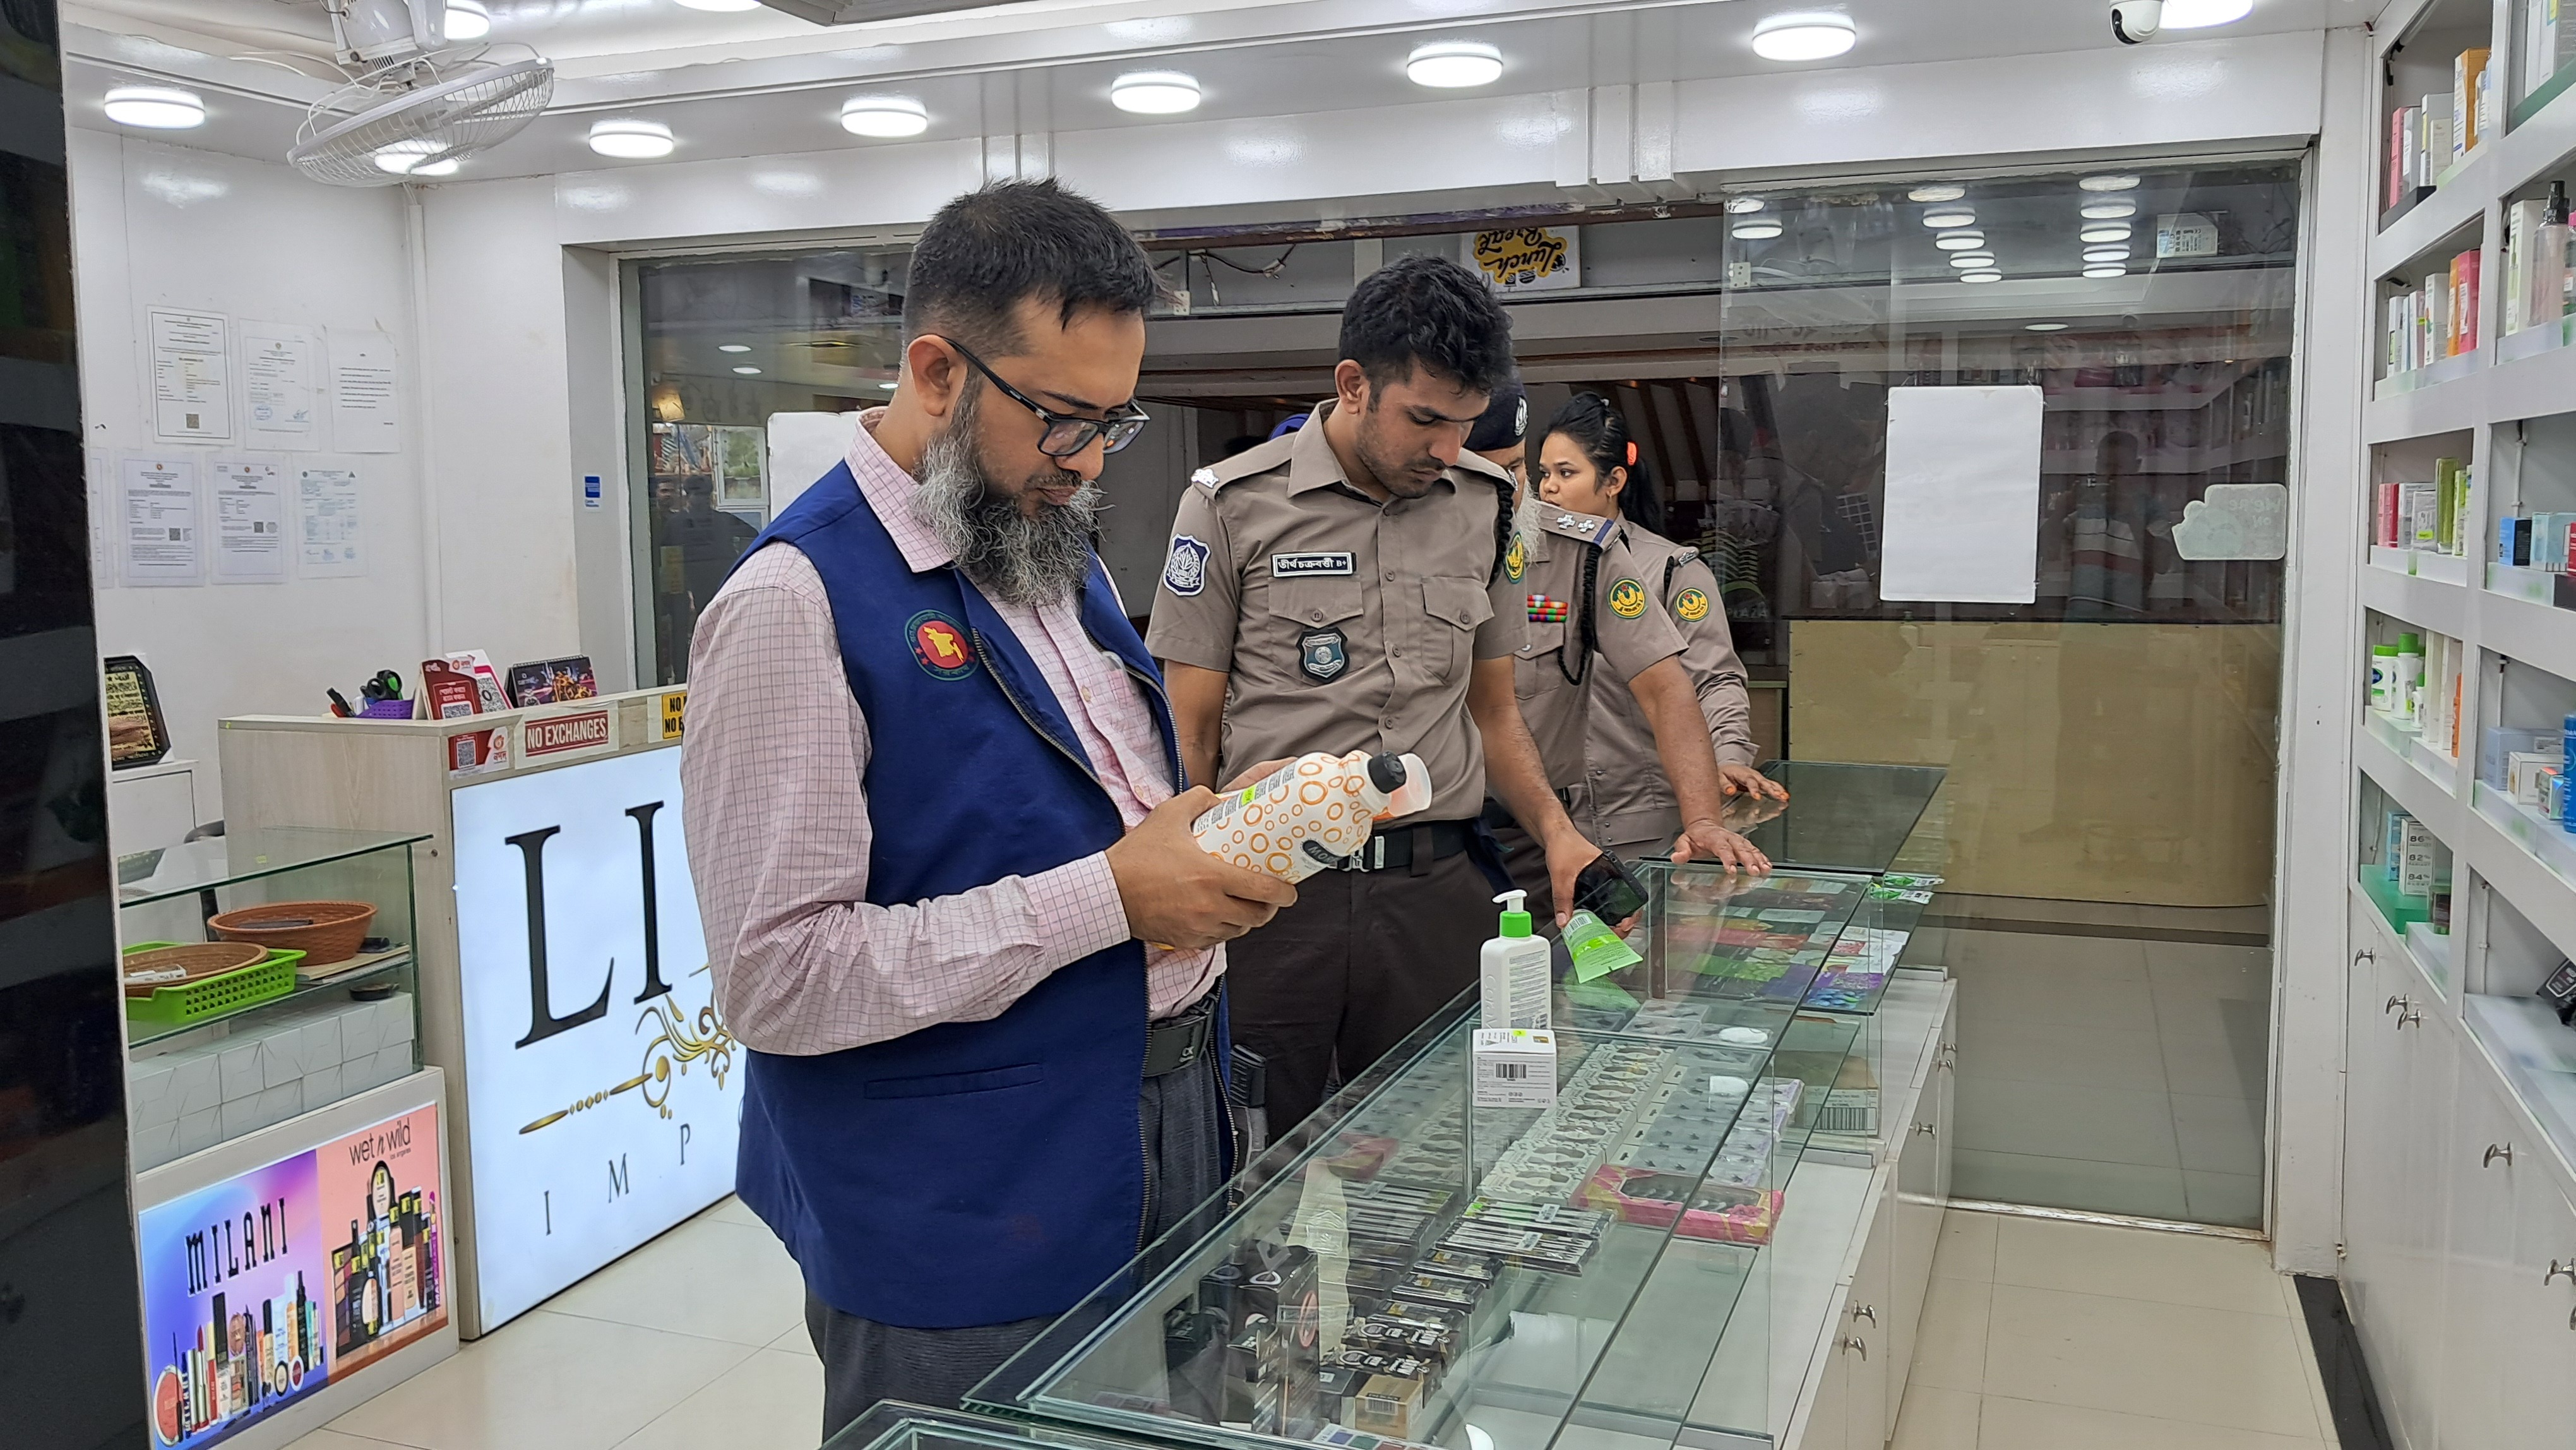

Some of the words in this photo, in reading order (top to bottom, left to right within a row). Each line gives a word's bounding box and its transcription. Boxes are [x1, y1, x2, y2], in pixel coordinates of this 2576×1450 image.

[1484, 241, 1562, 278] Lunch
[669, 697, 681, 712] NO
[527, 727, 542, 749] NO
[545, 718, 607, 746] EXCHANGES
[665, 717, 677, 733] NO
[349, 1132, 375, 1166] wet
[377, 1134, 385, 1156] n
[386, 1117, 411, 1151] wild
[185, 1197, 288, 1295] MILANI
